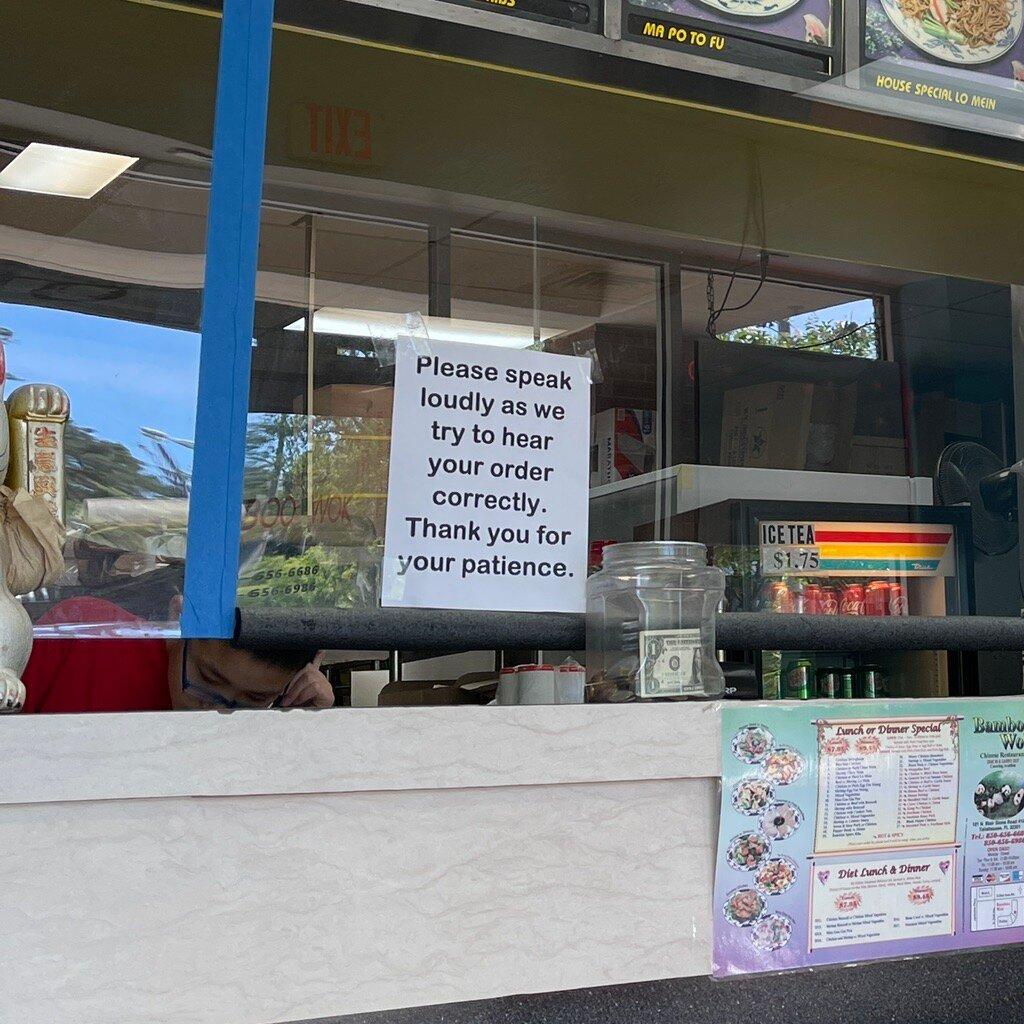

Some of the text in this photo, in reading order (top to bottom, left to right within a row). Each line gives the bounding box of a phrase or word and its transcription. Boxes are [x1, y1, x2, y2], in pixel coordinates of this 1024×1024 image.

[643, 22, 725, 50] MA PO TO FU
[876, 75, 996, 110] HOUSE SPECIAL LO MEIN
[416, 355, 572, 390] Please speak
[420, 387, 565, 420] loudly as we
[432, 420, 554, 450] try to hear
[428, 456, 554, 482] your order
[432, 489, 547, 516] correctly.
[406, 517, 572, 547] Thank you for
[762, 524, 815, 546] ICE TEA
[396, 554, 574, 578] your patience.
[774, 552, 819, 570] $1.75
[836, 724, 864, 736] Lunch
[878, 724, 908, 734] Dinner
[911, 724, 941, 736] Special
[838, 862, 930, 879] Diet Lunch & Dinner
